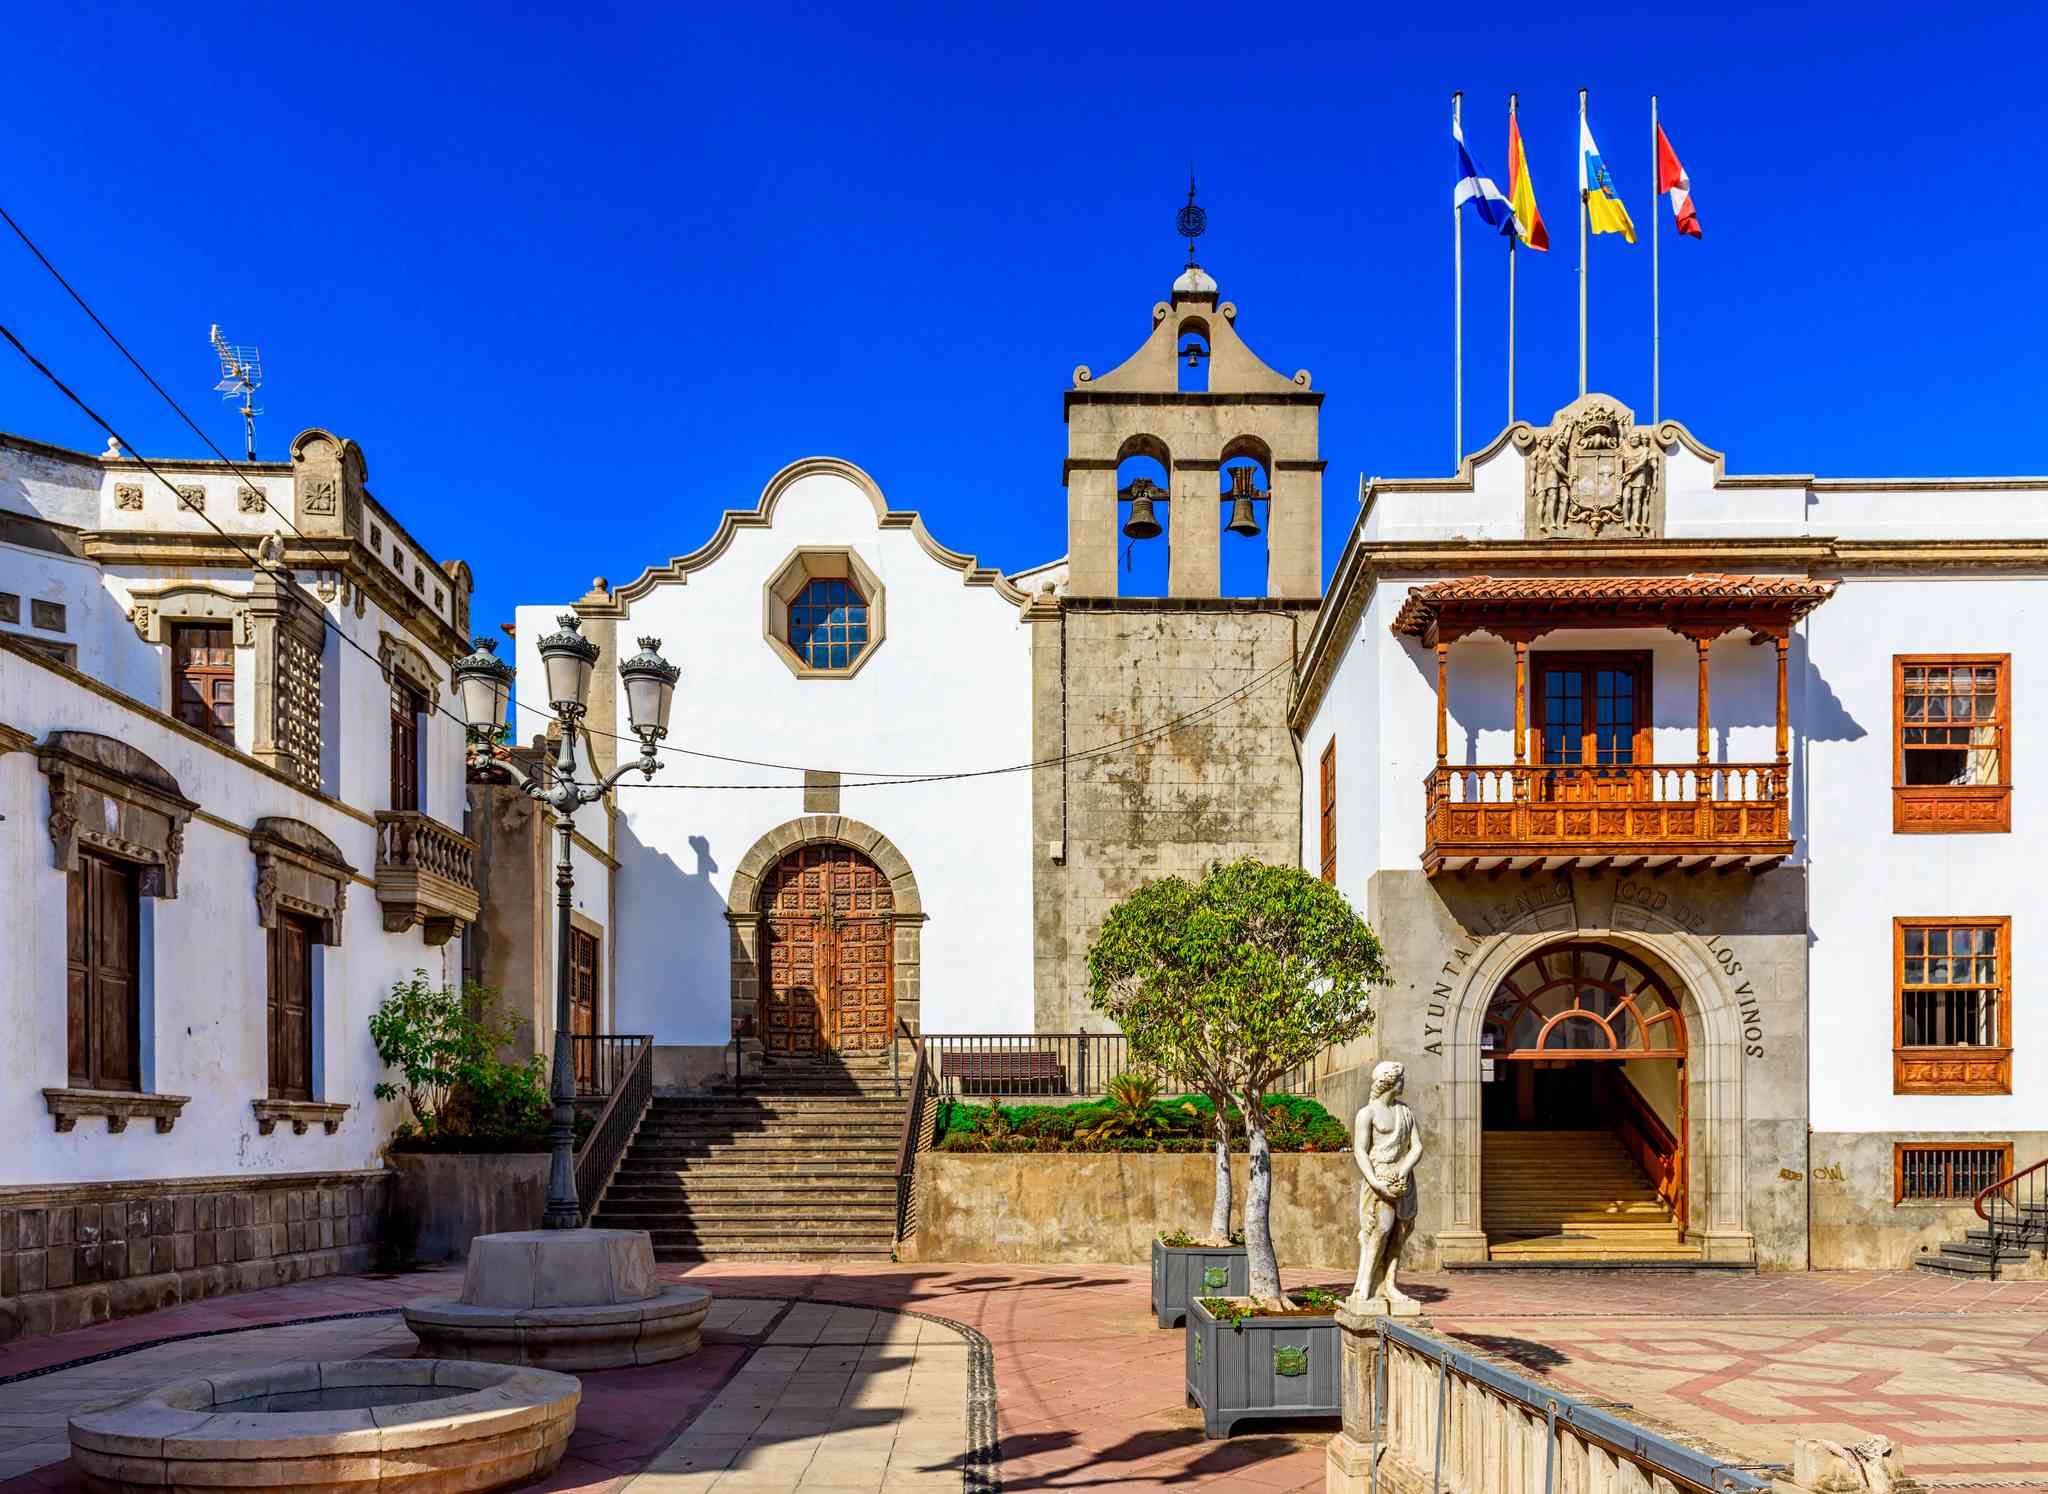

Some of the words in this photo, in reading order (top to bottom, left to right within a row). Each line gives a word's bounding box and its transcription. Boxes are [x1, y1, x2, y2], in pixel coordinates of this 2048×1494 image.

[1423, 880, 1570, 1056] AYUNTAMIENTO
[1615, 879, 1667, 909] ICOD
[1675, 905, 1705, 930] DE
[1705, 935, 1743, 976] LOS
[1735, 981, 1764, 1059] VINOS
